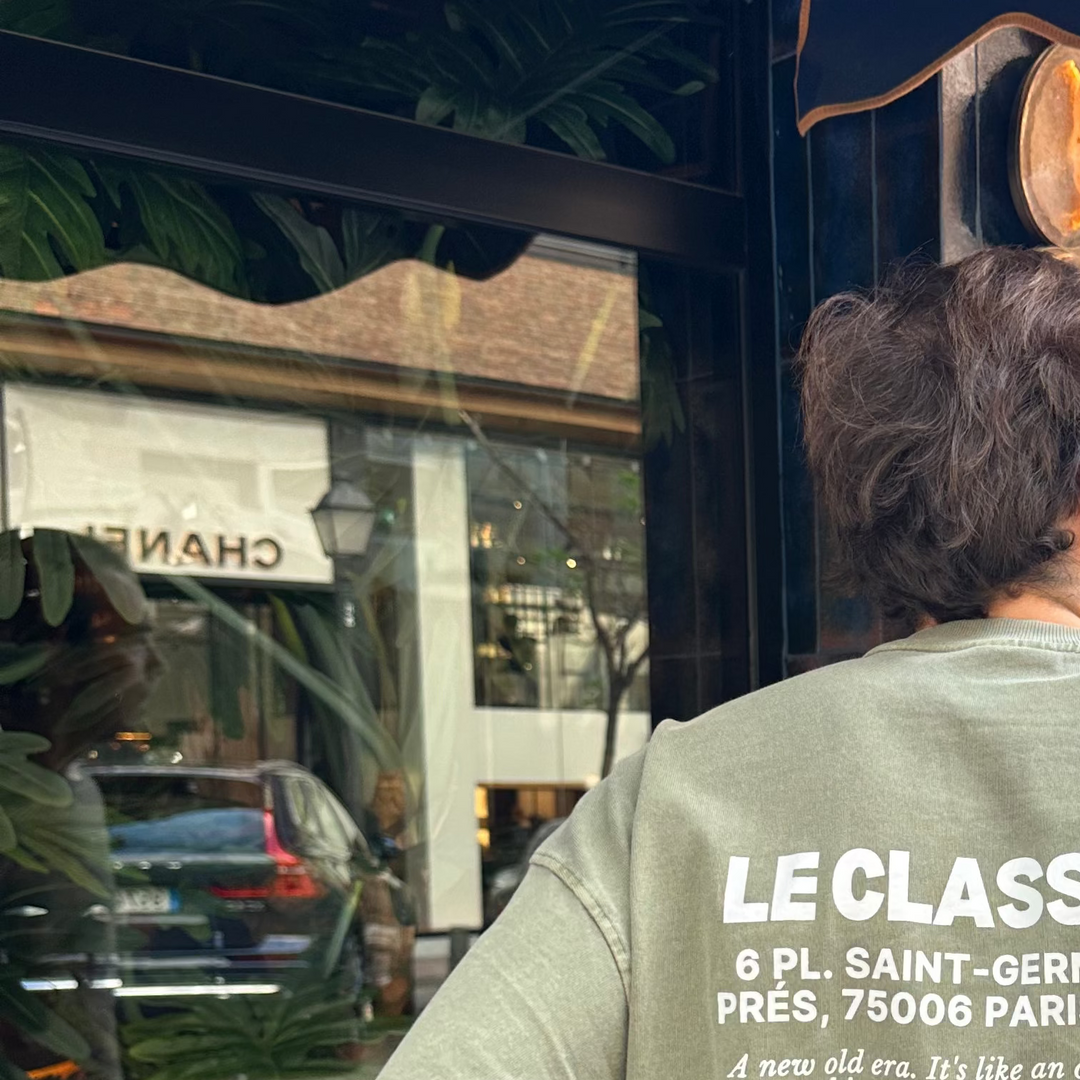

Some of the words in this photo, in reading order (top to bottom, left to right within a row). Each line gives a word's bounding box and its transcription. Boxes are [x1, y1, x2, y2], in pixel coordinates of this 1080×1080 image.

[722, 851, 820, 924] LE
[735, 948, 760, 982] 6
[772, 947, 833, 981] PL.
[716, 980, 833, 1029] PRÉS,
[841, 988, 973, 1028] 75006
[726, 1053, 749, 1079] A
[758, 1058, 816, 1078] new
[824, 1048, 865, 1075] old
[870, 1058, 917, 1080] era.
[1030, 1061, 1065, 1080] an
